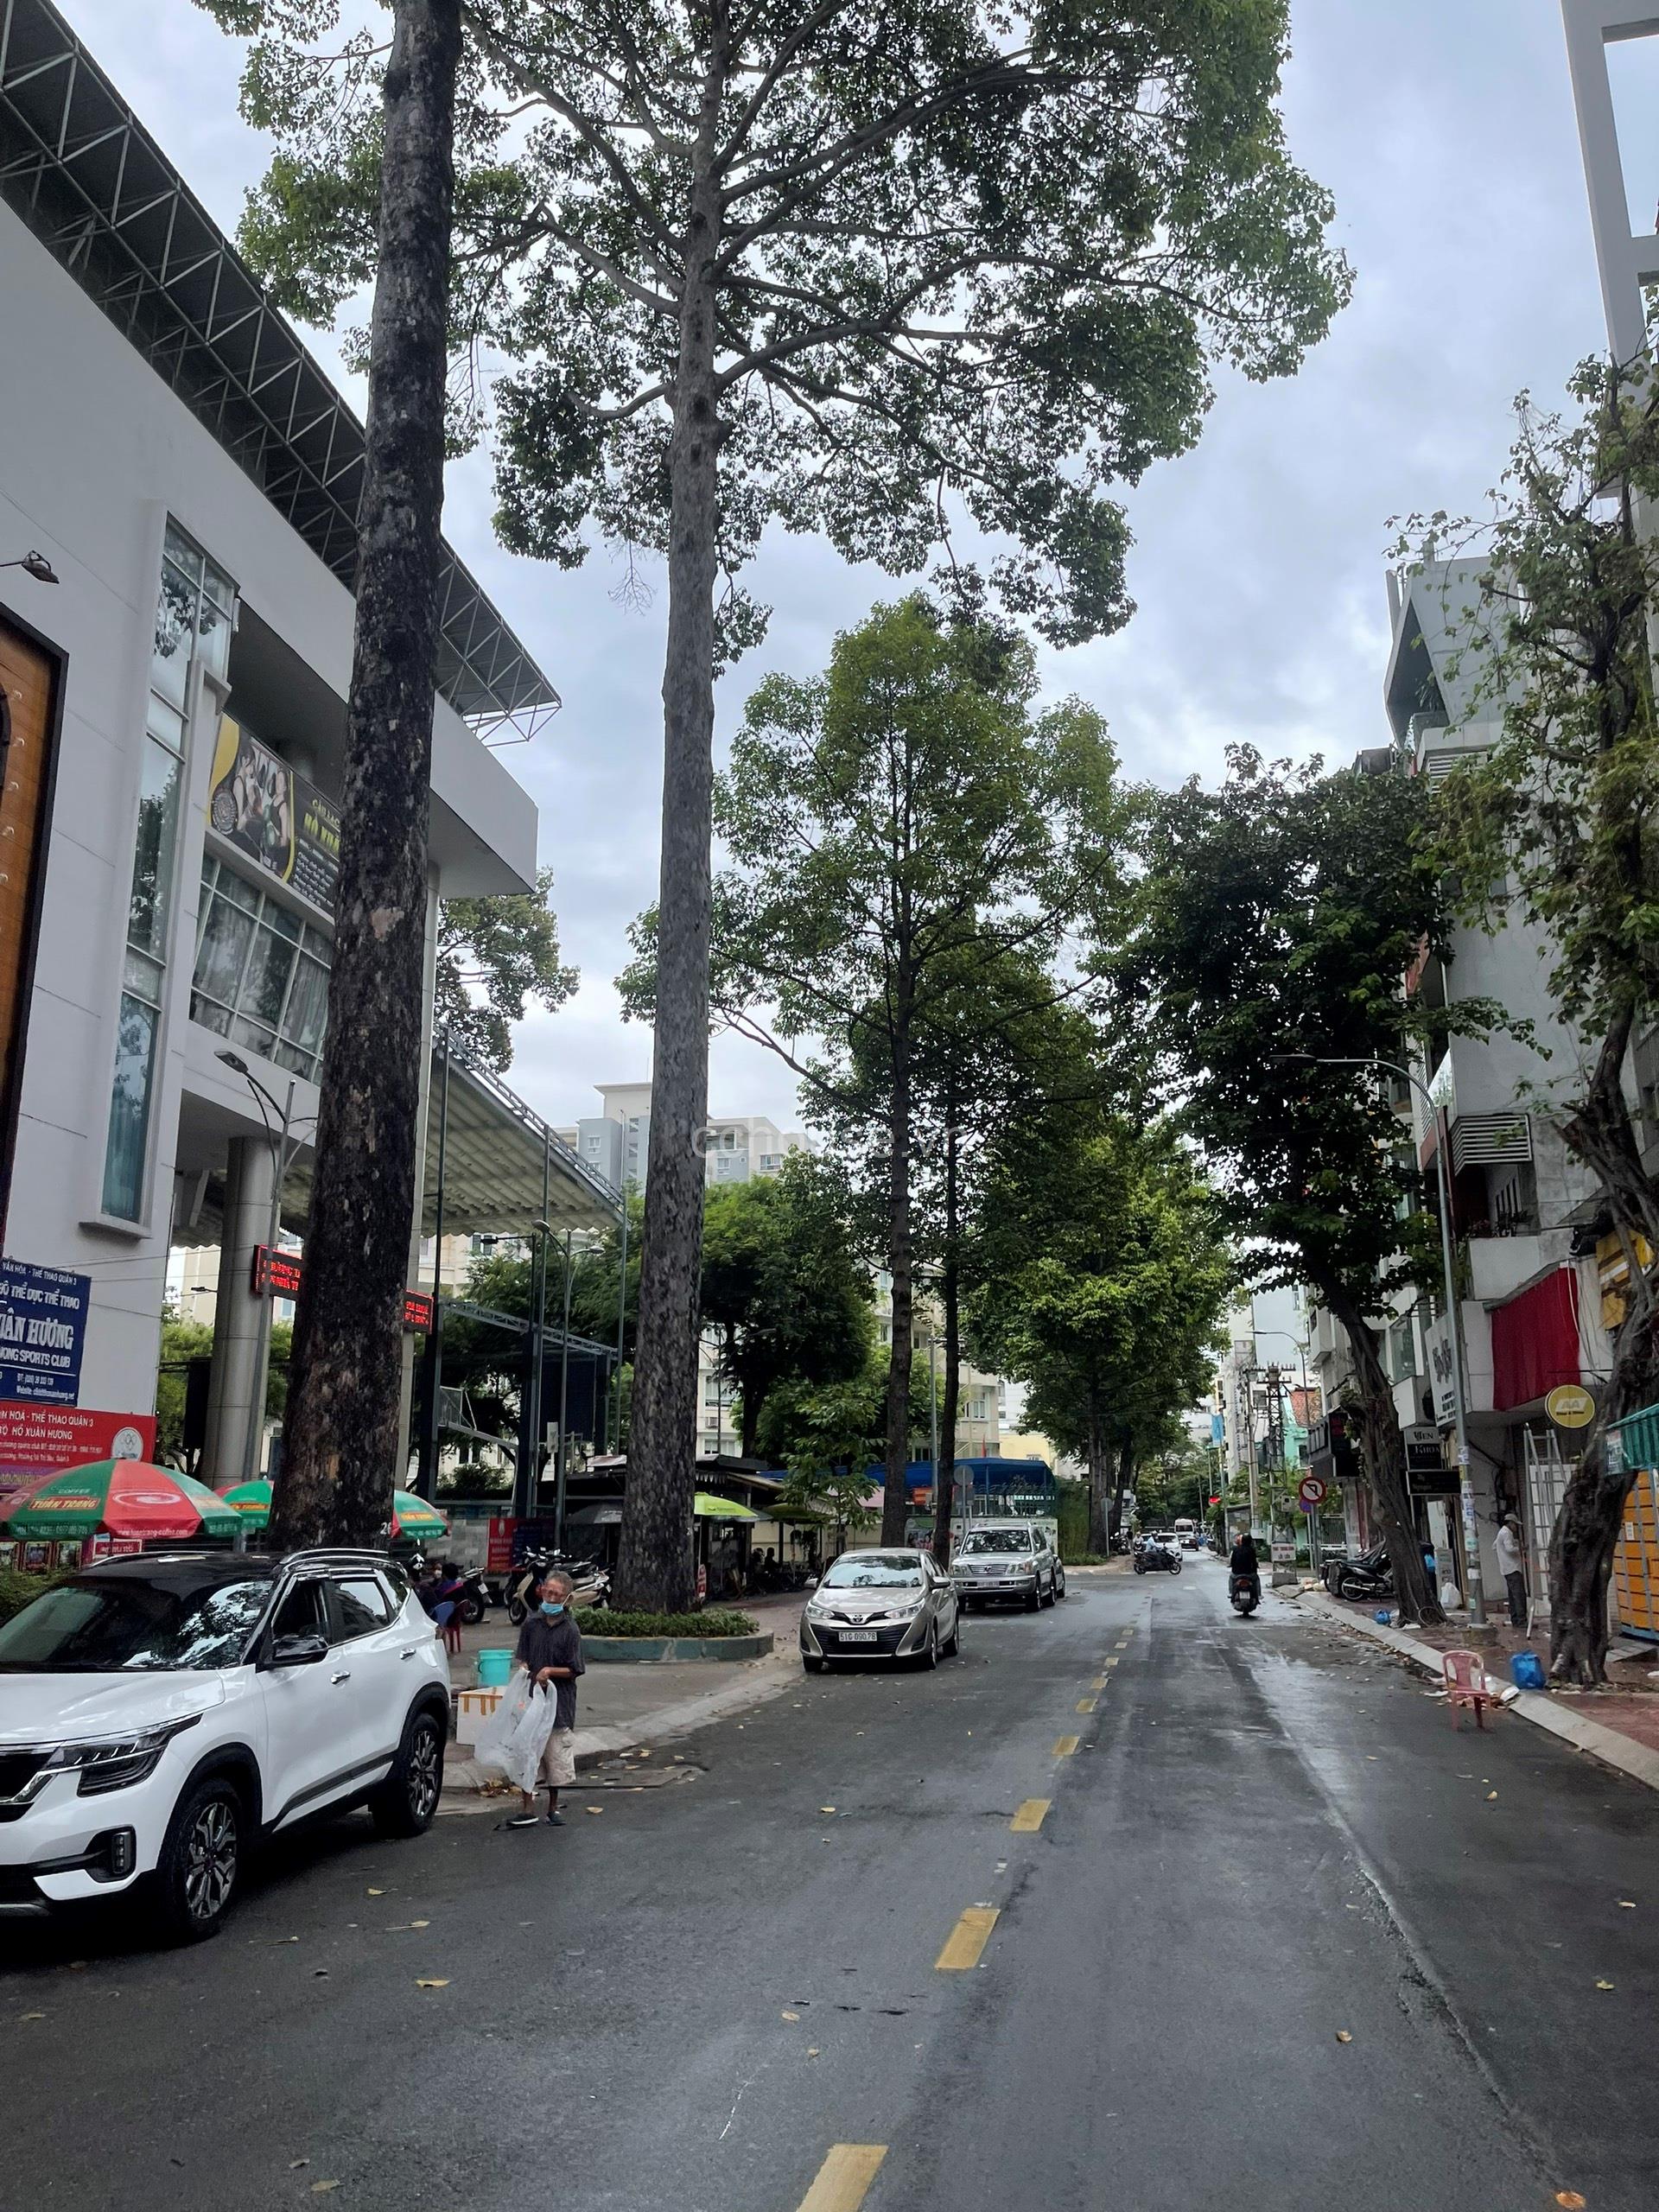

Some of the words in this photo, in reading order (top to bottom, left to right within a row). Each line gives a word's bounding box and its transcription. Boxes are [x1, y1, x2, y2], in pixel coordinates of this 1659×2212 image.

[43, 1271, 58, 1281] THAO
[10, 1281, 28, 1300] THỂ
[27, 1288, 44, 1305] DỤC
[44, 1289, 60, 1306] THỂ
[60, 1294, 80, 1310] THAO
[26, 1317, 74, 1351] HƯƠNG
[19, 1349, 50, 1366] SPORTS
[51, 1354, 71, 1369] CLUB
[31, 1409, 46, 1423] THỂ
[48, 1414, 67, 1425] THAO
[89, 1418, 93, 1427] 3
[25, 1426, 46, 1438] XUÂN
[47, 1429, 73, 1440] HƯƠNG
